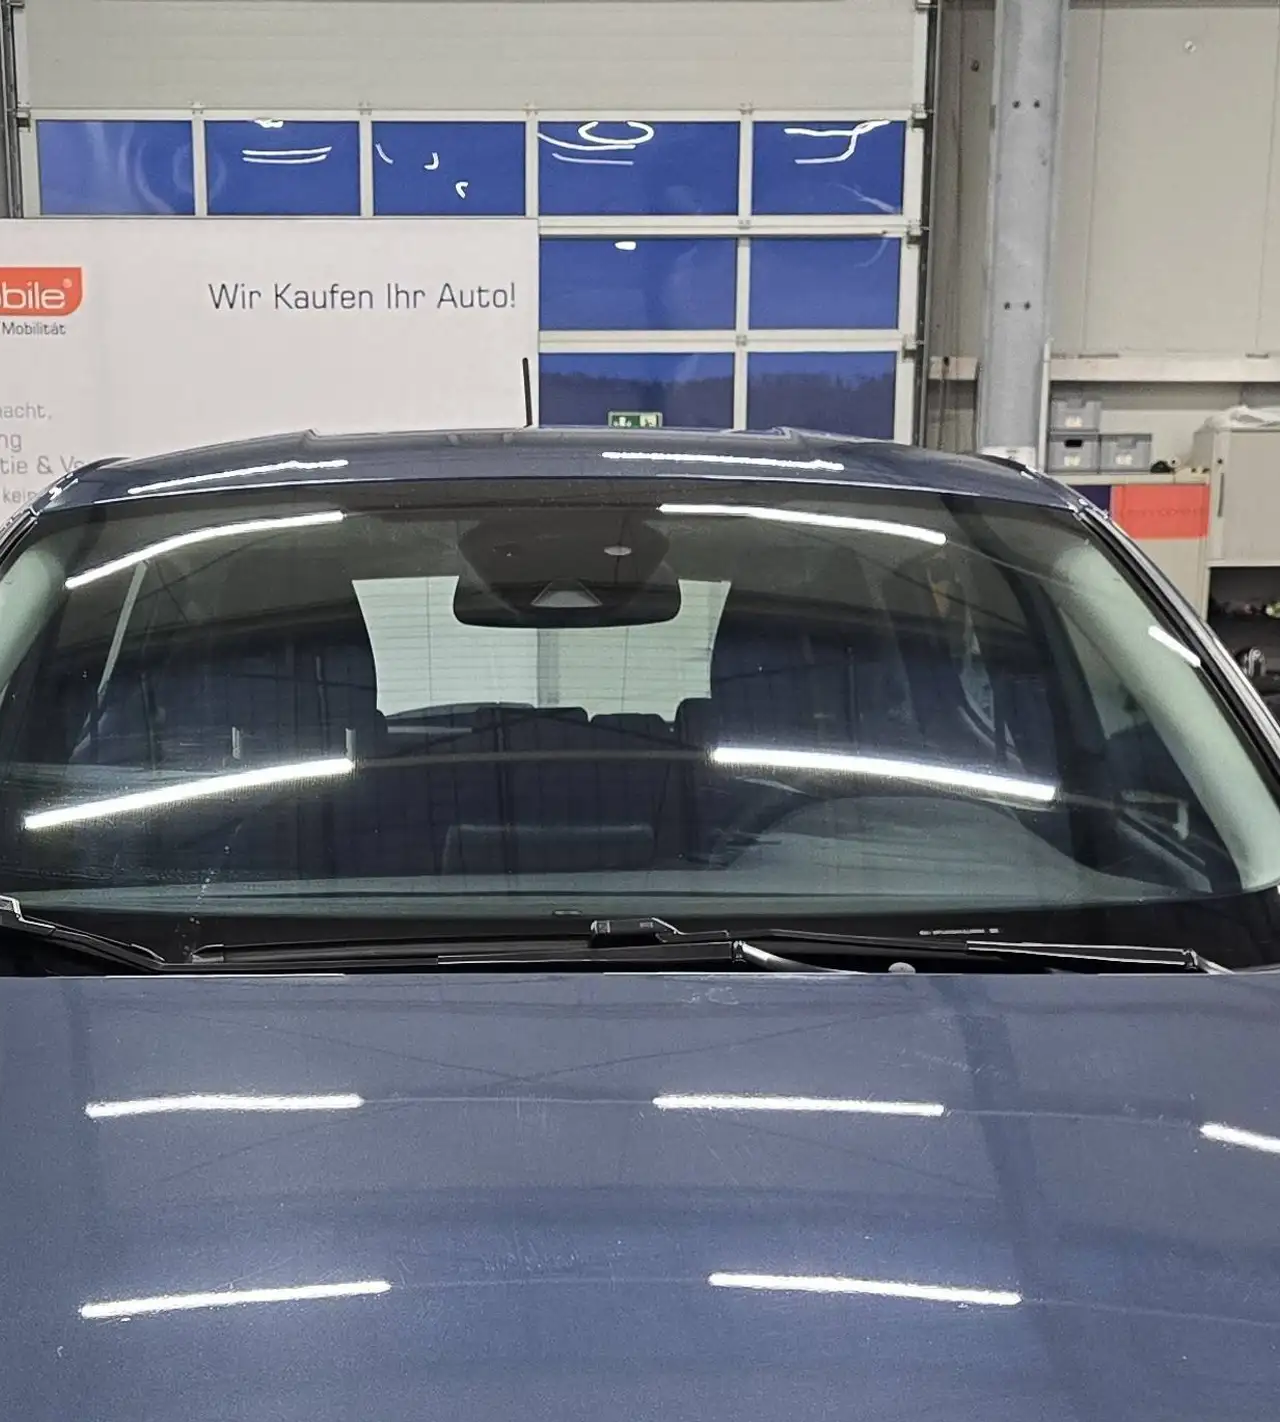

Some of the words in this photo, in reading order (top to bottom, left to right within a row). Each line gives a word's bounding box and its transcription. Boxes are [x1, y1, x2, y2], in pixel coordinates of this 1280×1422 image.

[207, 282, 262, 310] Wir
[273, 282, 374, 310] Kaufen
[386, 283, 426, 310] Ihr
[436, 282, 516, 310] Auto!
[1, 320, 67, 336] Mobilität
[36, 455, 54, 475] &
